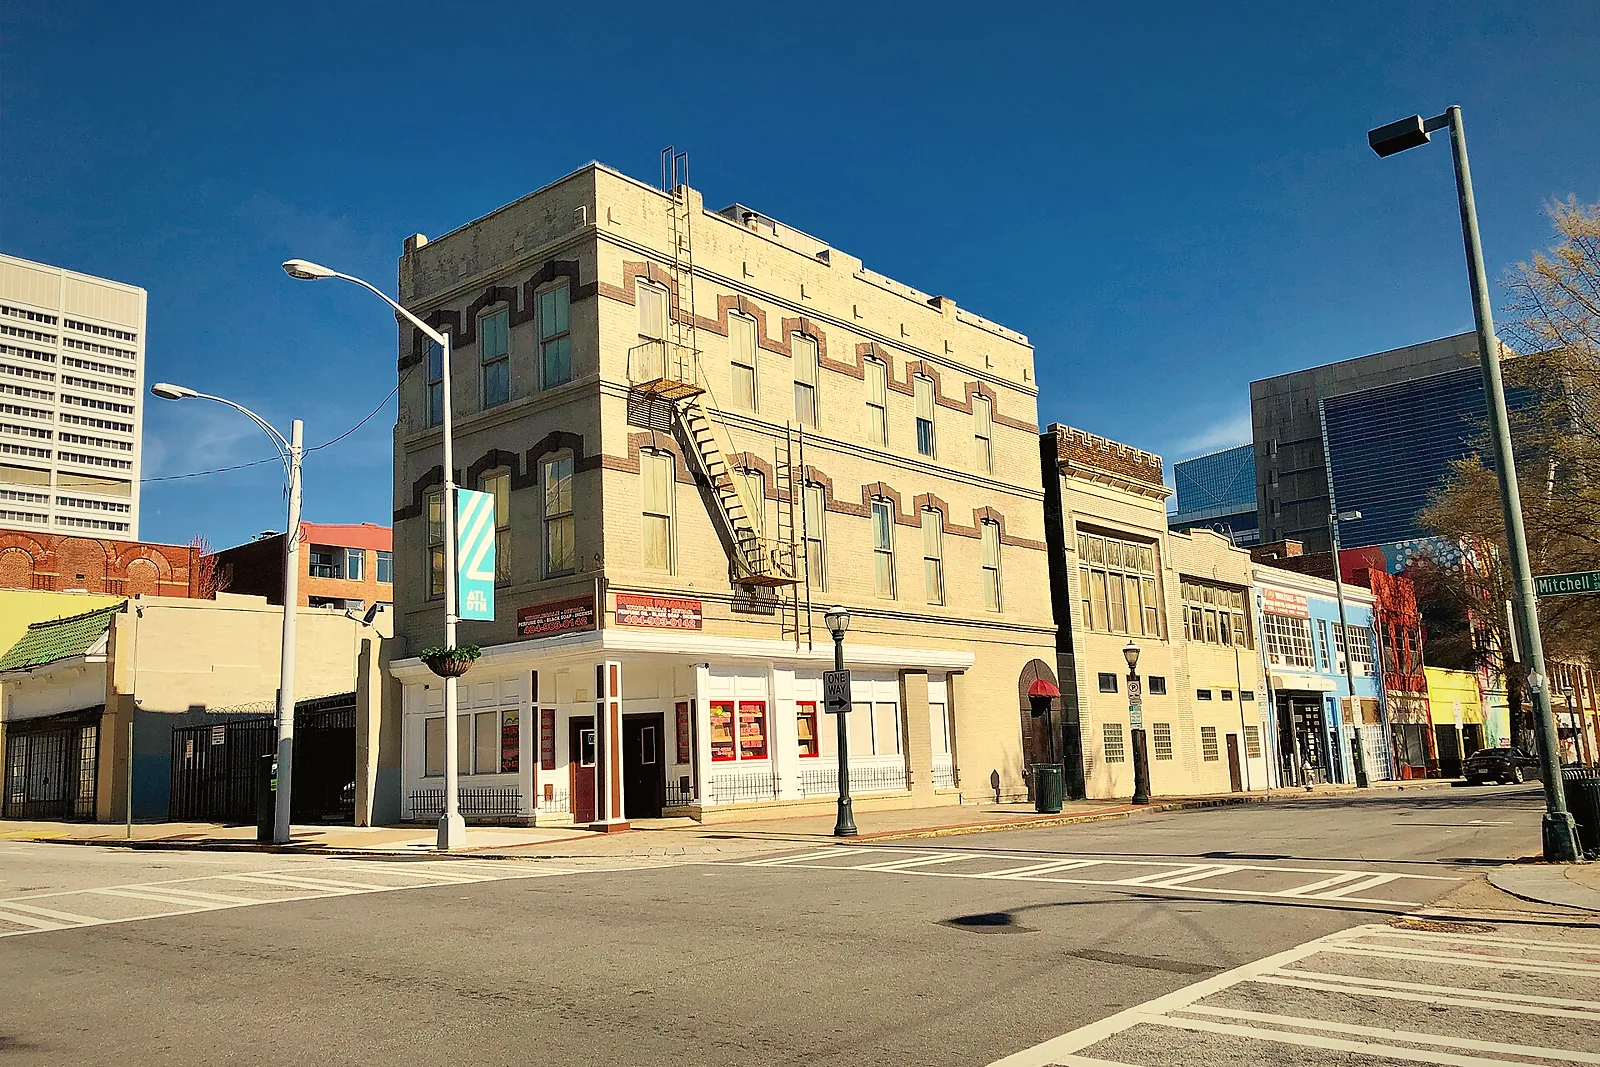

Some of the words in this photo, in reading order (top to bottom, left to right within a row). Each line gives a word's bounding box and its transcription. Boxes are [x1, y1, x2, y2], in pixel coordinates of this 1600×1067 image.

[1539, 575, 1590, 593] Mitchell
[466, 589, 487, 601] ATL
[466, 600, 487, 612] DTN
[518, 620, 536, 628] PERFUME
[827, 672, 847, 684] ONE
[827, 684, 847, 696] WAY
